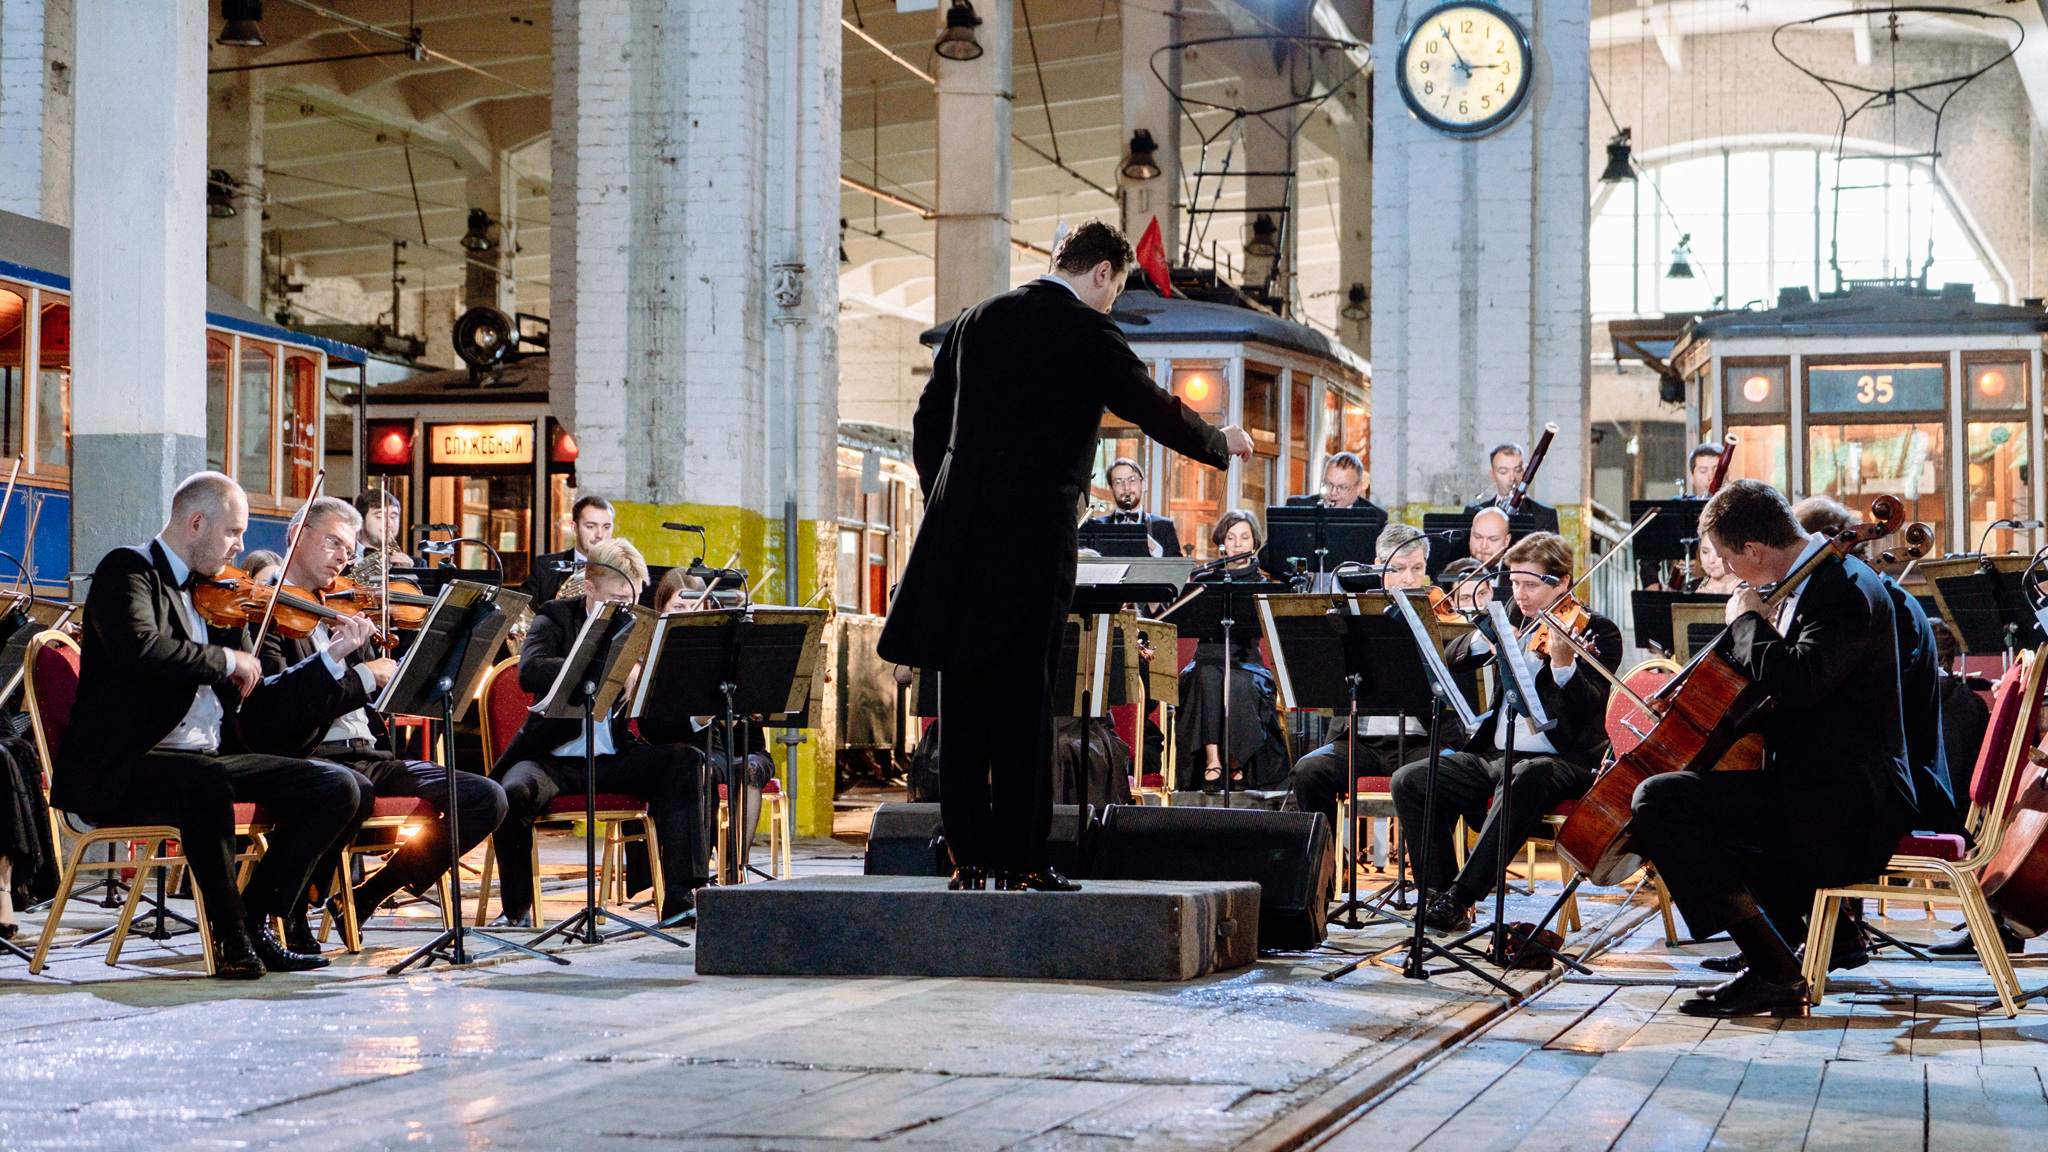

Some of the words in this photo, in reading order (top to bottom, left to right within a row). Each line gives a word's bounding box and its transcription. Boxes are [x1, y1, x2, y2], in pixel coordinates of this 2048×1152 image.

[1461, 21, 1473, 34] 12
[1425, 41, 1438, 54] 10
[1496, 40, 1505, 53] 2
[1420, 61, 1430, 74] 9
[1501, 61, 1511, 75] 3
[1424, 81, 1434, 95] 8
[1495, 82, 1505, 95] 4
[1441, 95, 1450, 109] 7
[1458, 100, 1468, 114] 6
[1481, 96, 1490, 109] 5
[1857, 375, 1894, 404] 35
